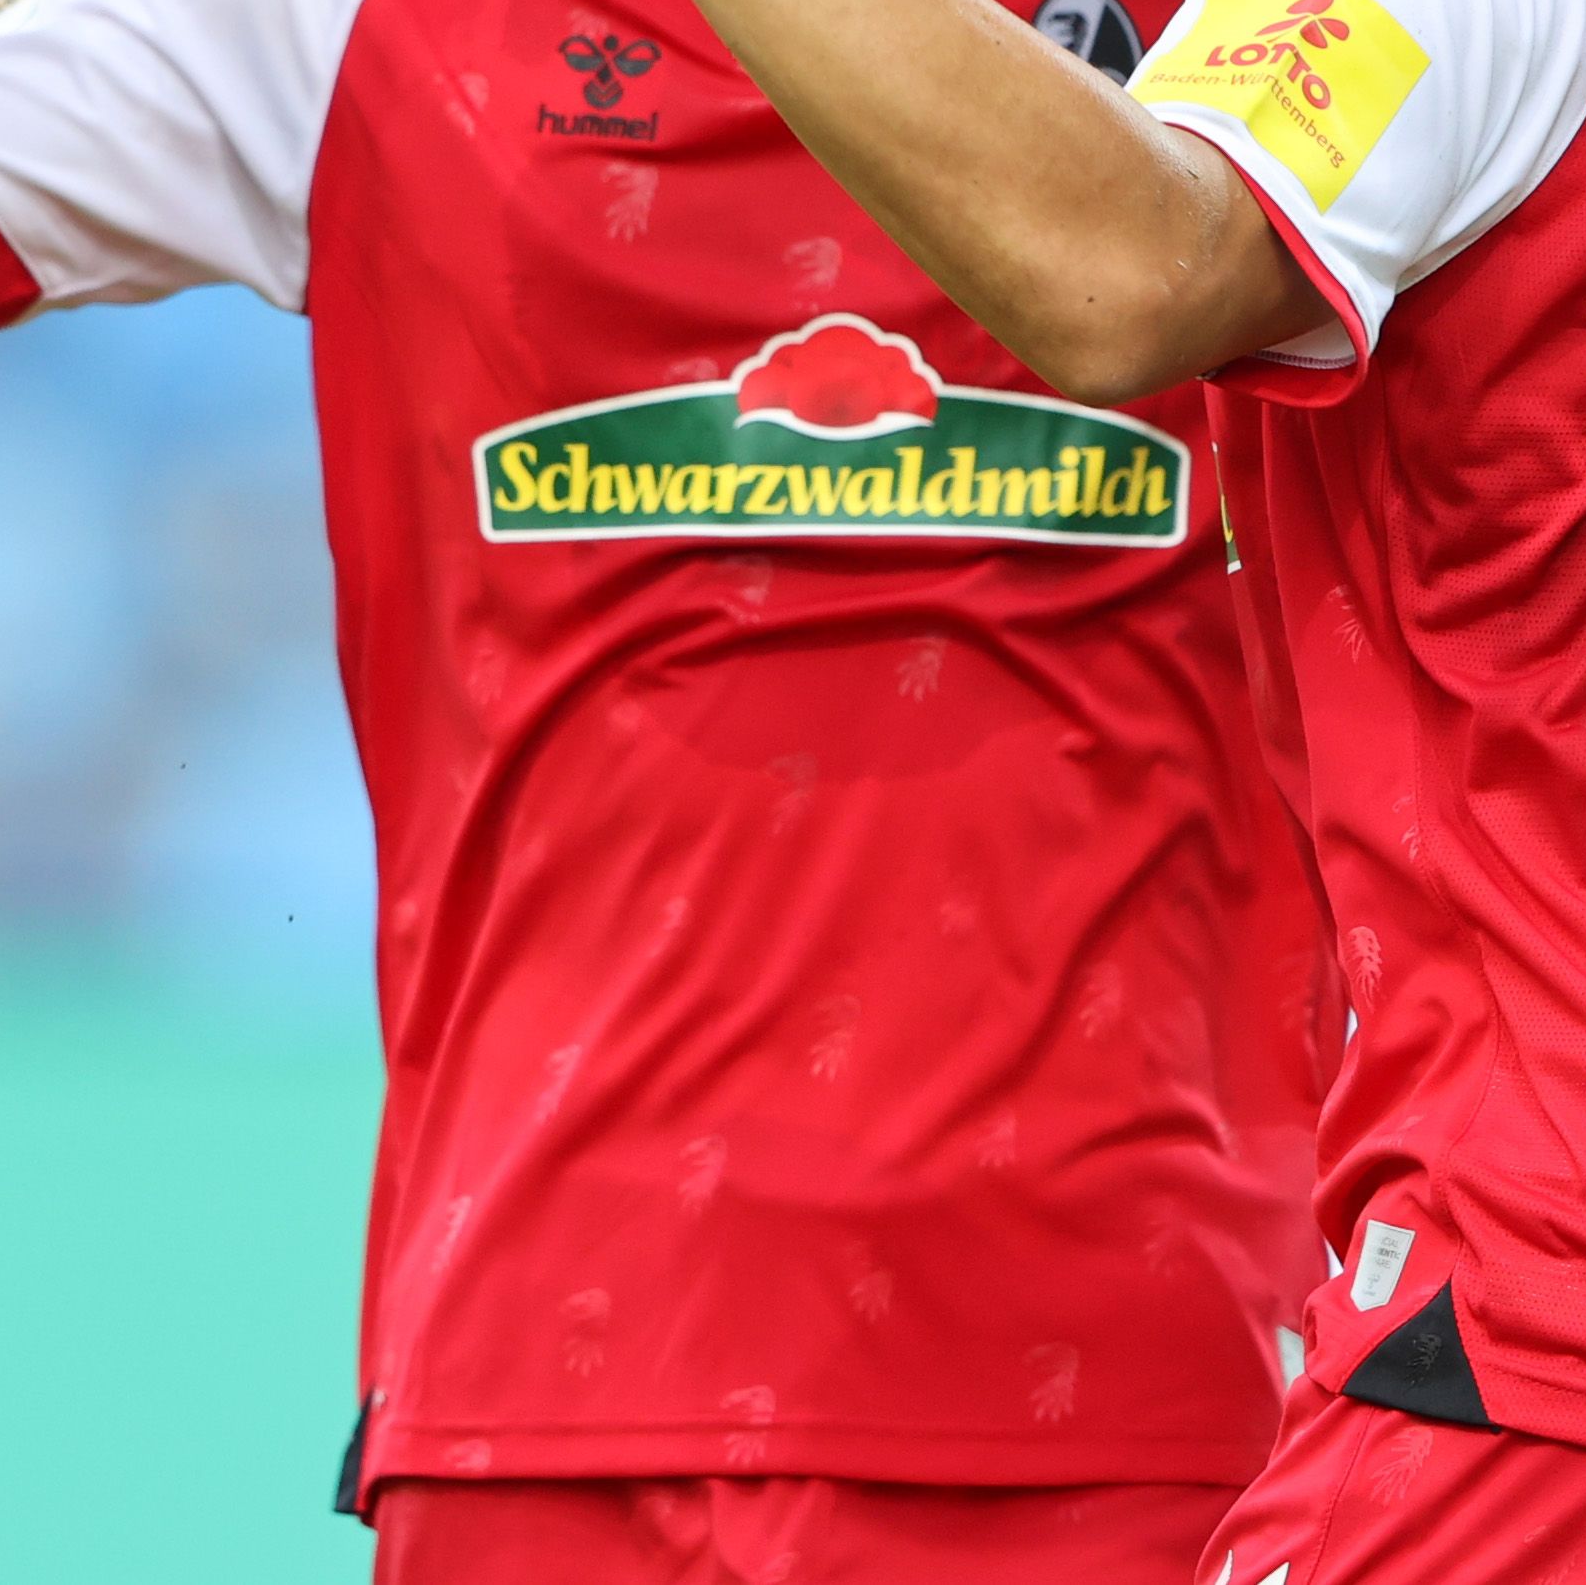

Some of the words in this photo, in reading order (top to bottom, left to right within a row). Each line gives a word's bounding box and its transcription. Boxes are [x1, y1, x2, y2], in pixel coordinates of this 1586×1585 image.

[1204, 43, 1331, 110] LOTTO
[536, 103, 659, 141] hummel
[494, 441, 1172, 518] Schwarzwaldmilch
